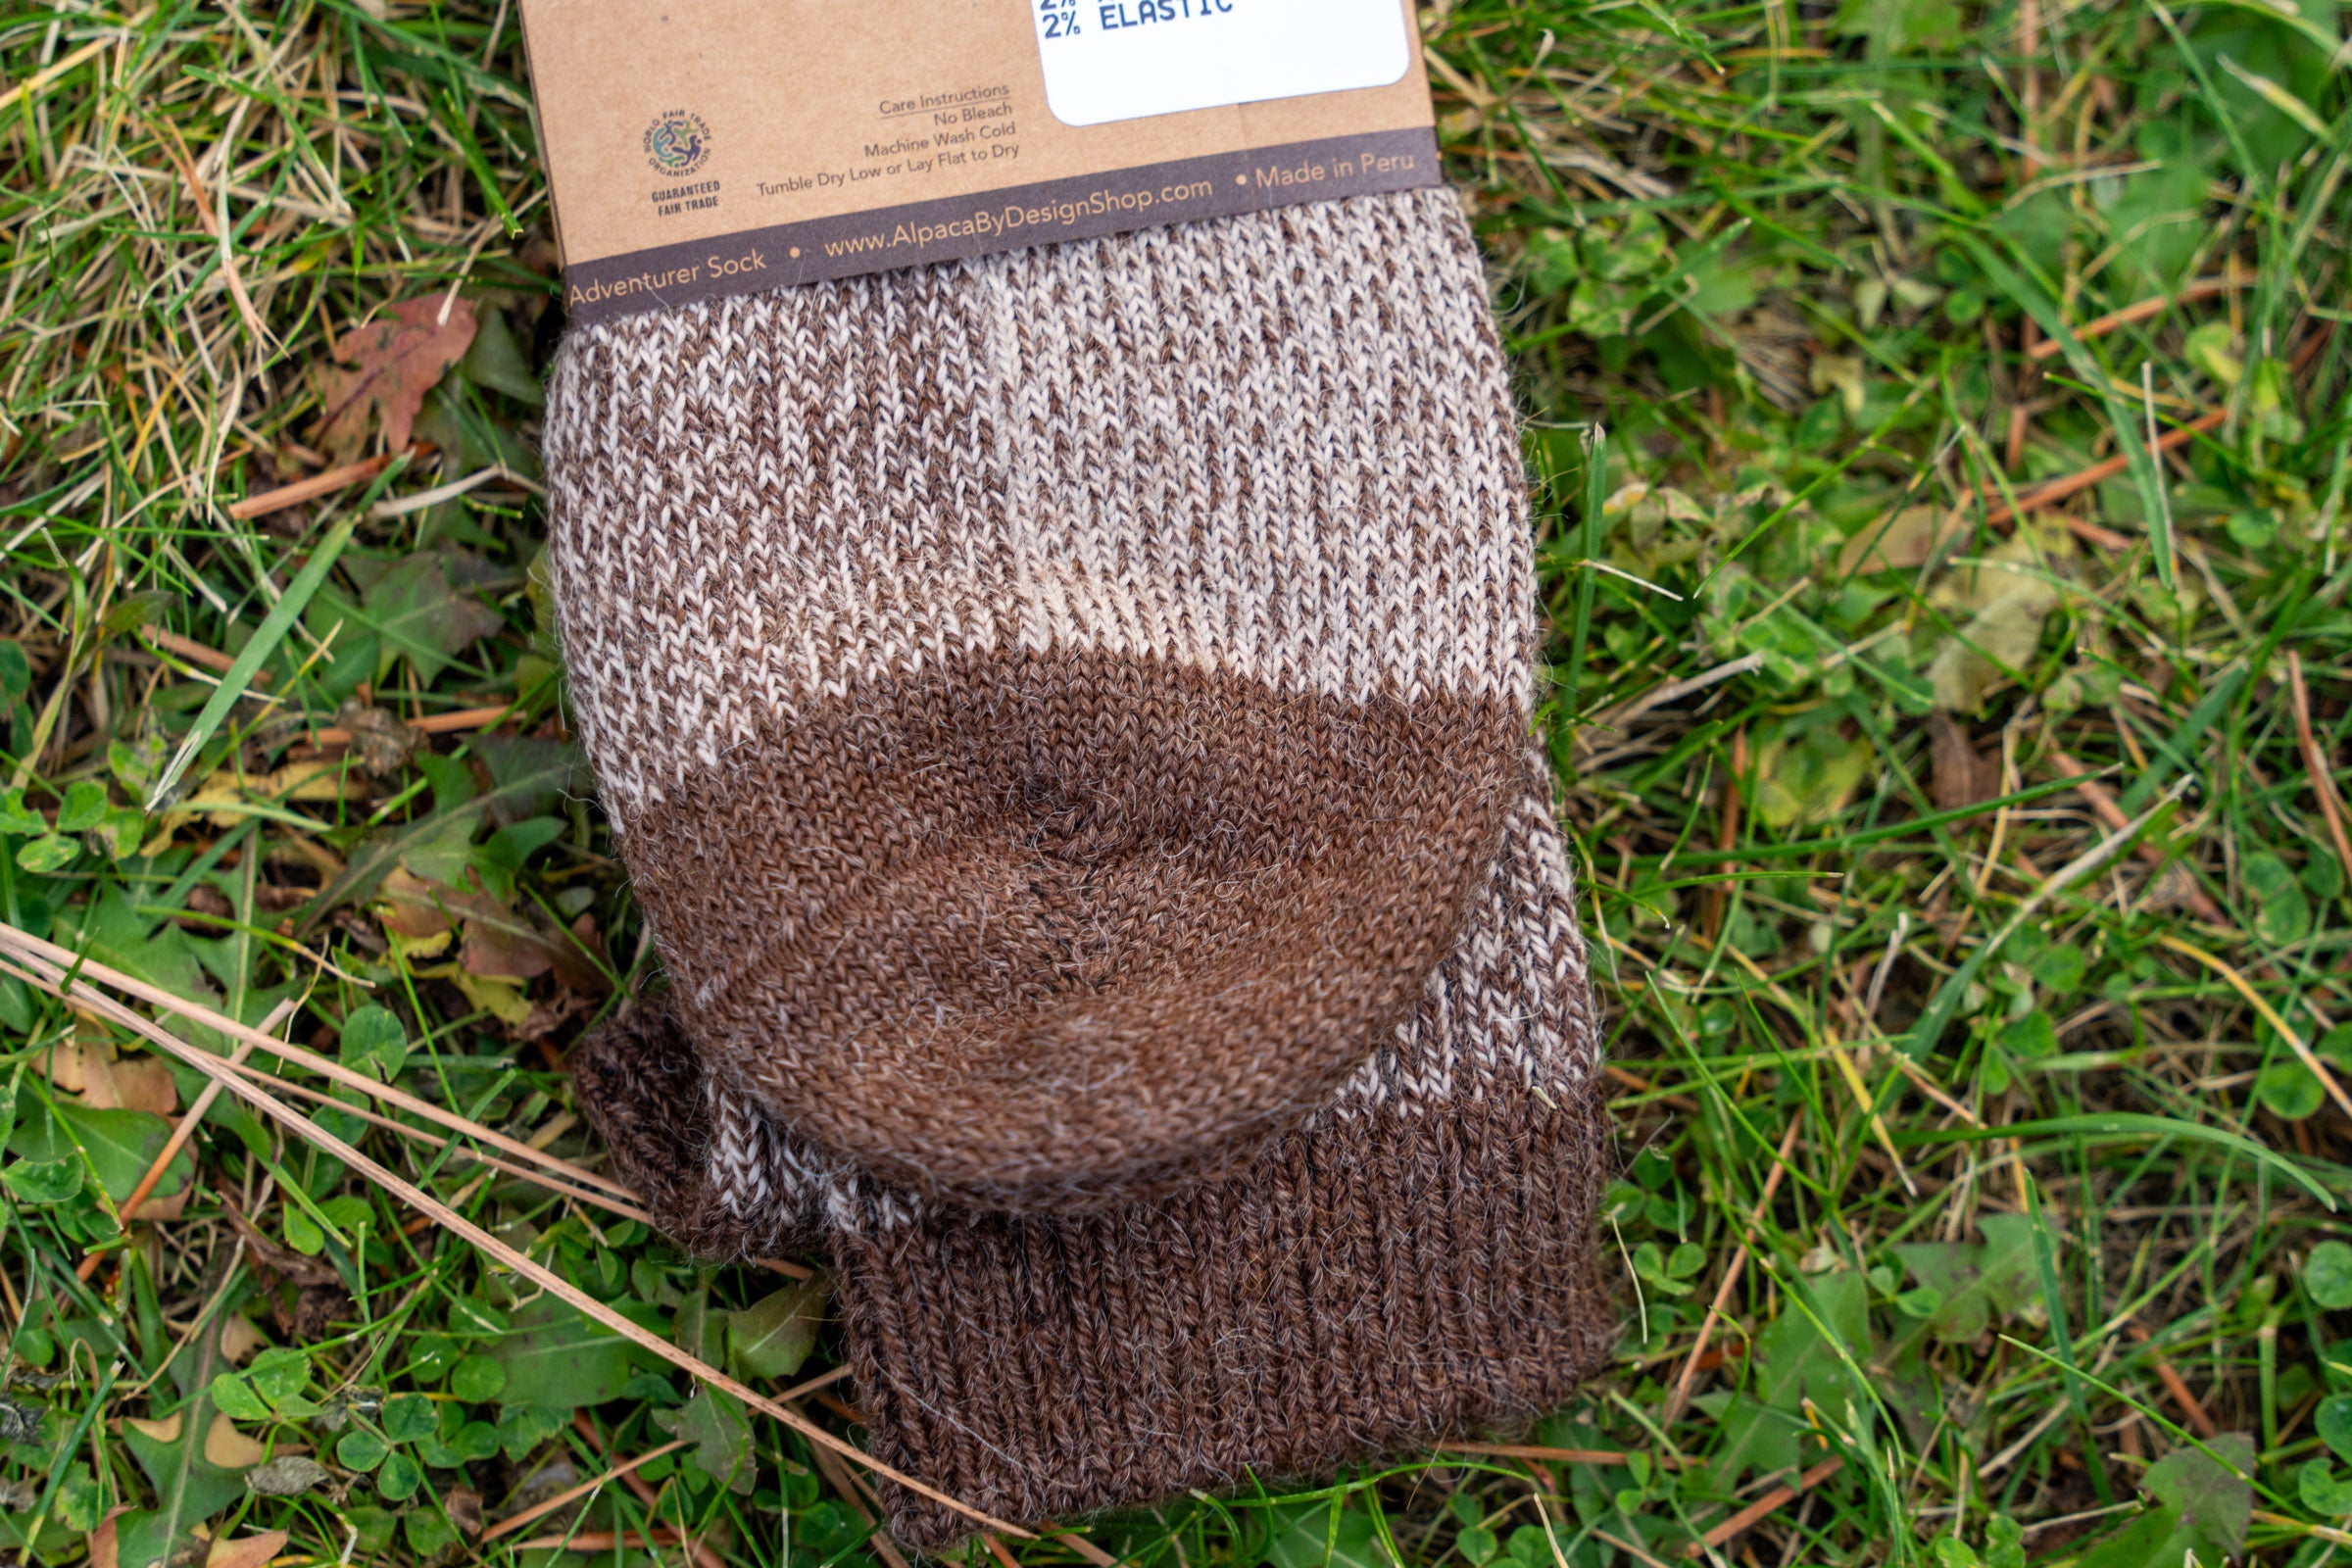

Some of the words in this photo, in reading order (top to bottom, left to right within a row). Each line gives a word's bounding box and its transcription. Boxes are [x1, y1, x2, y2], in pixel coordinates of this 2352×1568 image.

[1042, 10, 1081, 39] 2%
[662, 109, 686, 119] FAIR
[878, 99, 916, 115] Care
[919, 84, 1010, 108] Instructions
[933, 112, 958, 126] No
[961, 102, 1013, 122] Bleach
[863, 136, 930, 158] Machine
[932, 127, 975, 147] Wash
[979, 122, 1016, 140] Cold
[757, 175, 812, 197] Tumble
[816, 172, 845, 187] Dry
[849, 166, 882, 182] Low
[886, 162, 903, 175] or
[906, 157, 933, 173] Lay
[937, 151, 966, 168] Flat
[971, 149, 988, 162] to
[991, 143, 1020, 158] Dry
[651, 179, 721, 203] GUARANTEED
[658, 202, 682, 217] FAIR
[684, 195, 719, 212] TRADE
[568, 264, 701, 308] Adventurer
[706, 248, 767, 279] Sock
[823, 178, 1214, 259] www.AlpacaByDesignShop.com
[1254, 160, 1326, 189] Made
[1332, 157, 1354, 179] in
[1359, 152, 1416, 174] Peru
